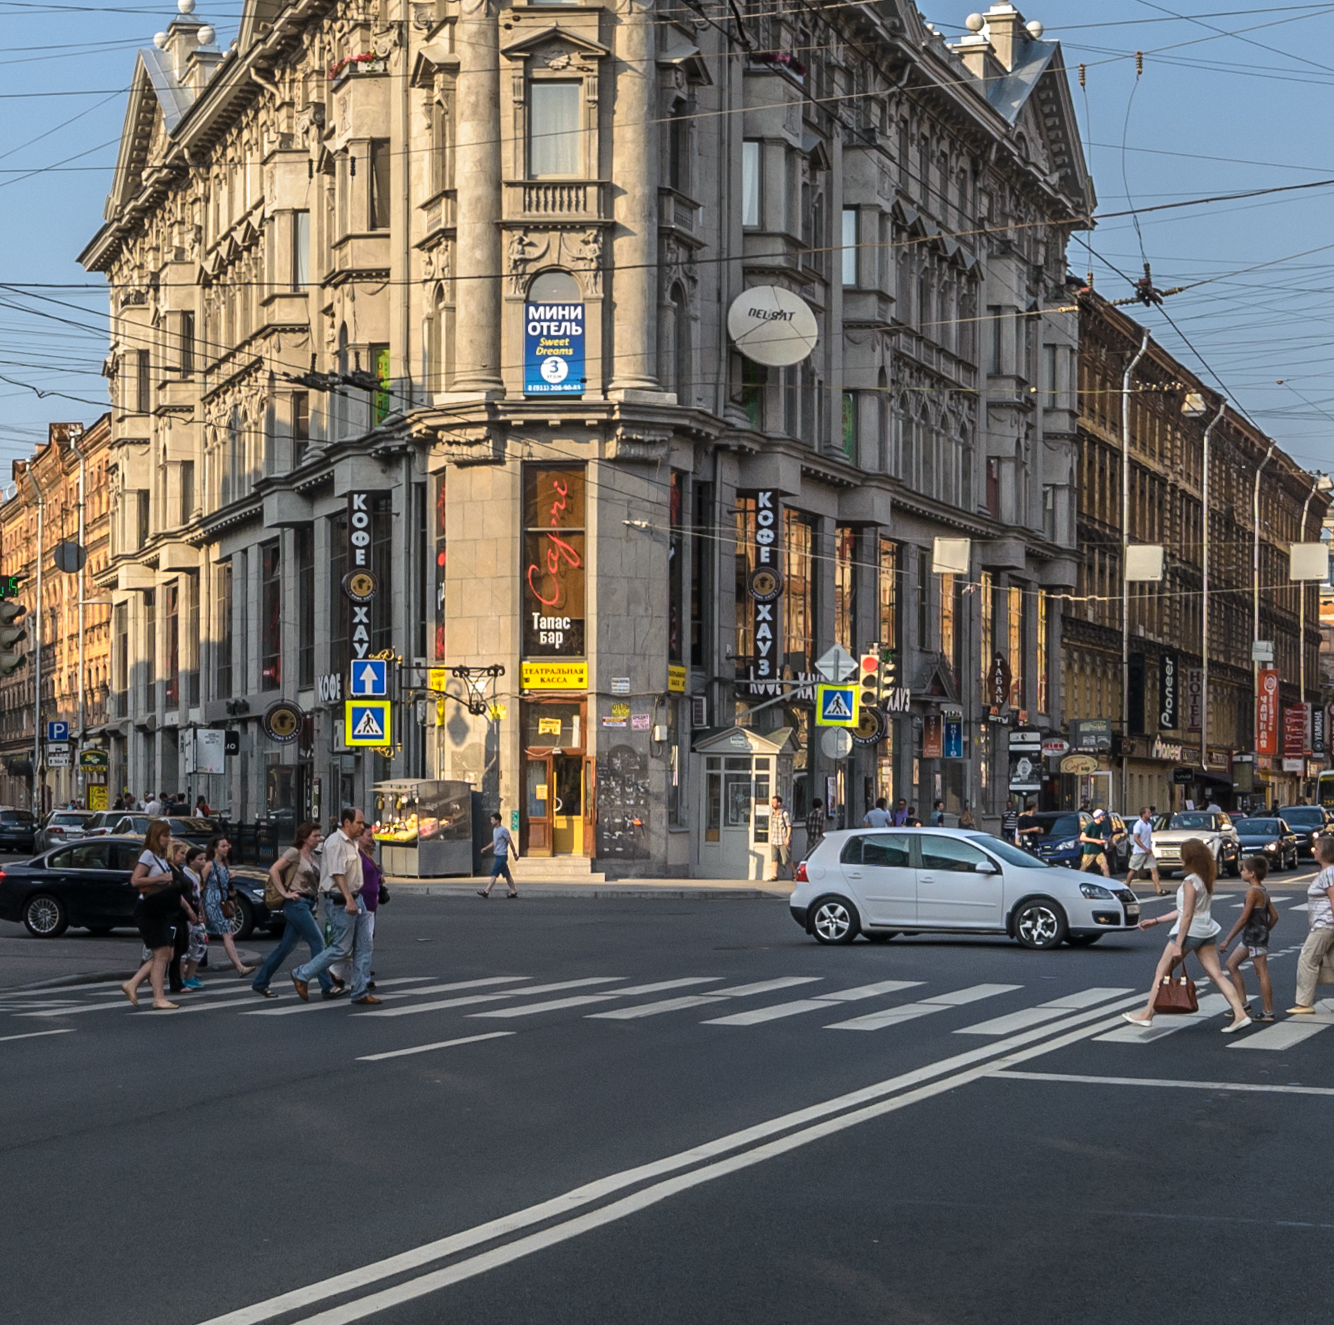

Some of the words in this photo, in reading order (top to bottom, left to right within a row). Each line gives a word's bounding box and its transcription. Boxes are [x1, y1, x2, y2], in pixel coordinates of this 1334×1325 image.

[528, 305, 582, 320] МИНИ
[527, 321, 583, 336] ОТЕЛЬ
[540, 338, 570, 346] Sweet
[536, 347, 573, 355] Dreams
[549, 359, 559, 373] 3
[351, 493, 370, 565] КОФЕ
[756, 492, 775, 563] КОФЕ
[532, 612, 571, 630] Тапас
[539, 631, 563, 649] бар
[756, 605, 773, 676] ХАУЗ
[319, 673, 341, 702] КОФЕ
[995, 658, 1003, 704] ТАБАК
[1160, 657, 1173, 728] Pioneer
[1189, 671, 1201, 728] HOTEL
[1314, 710, 1323, 741] YAMAHA
